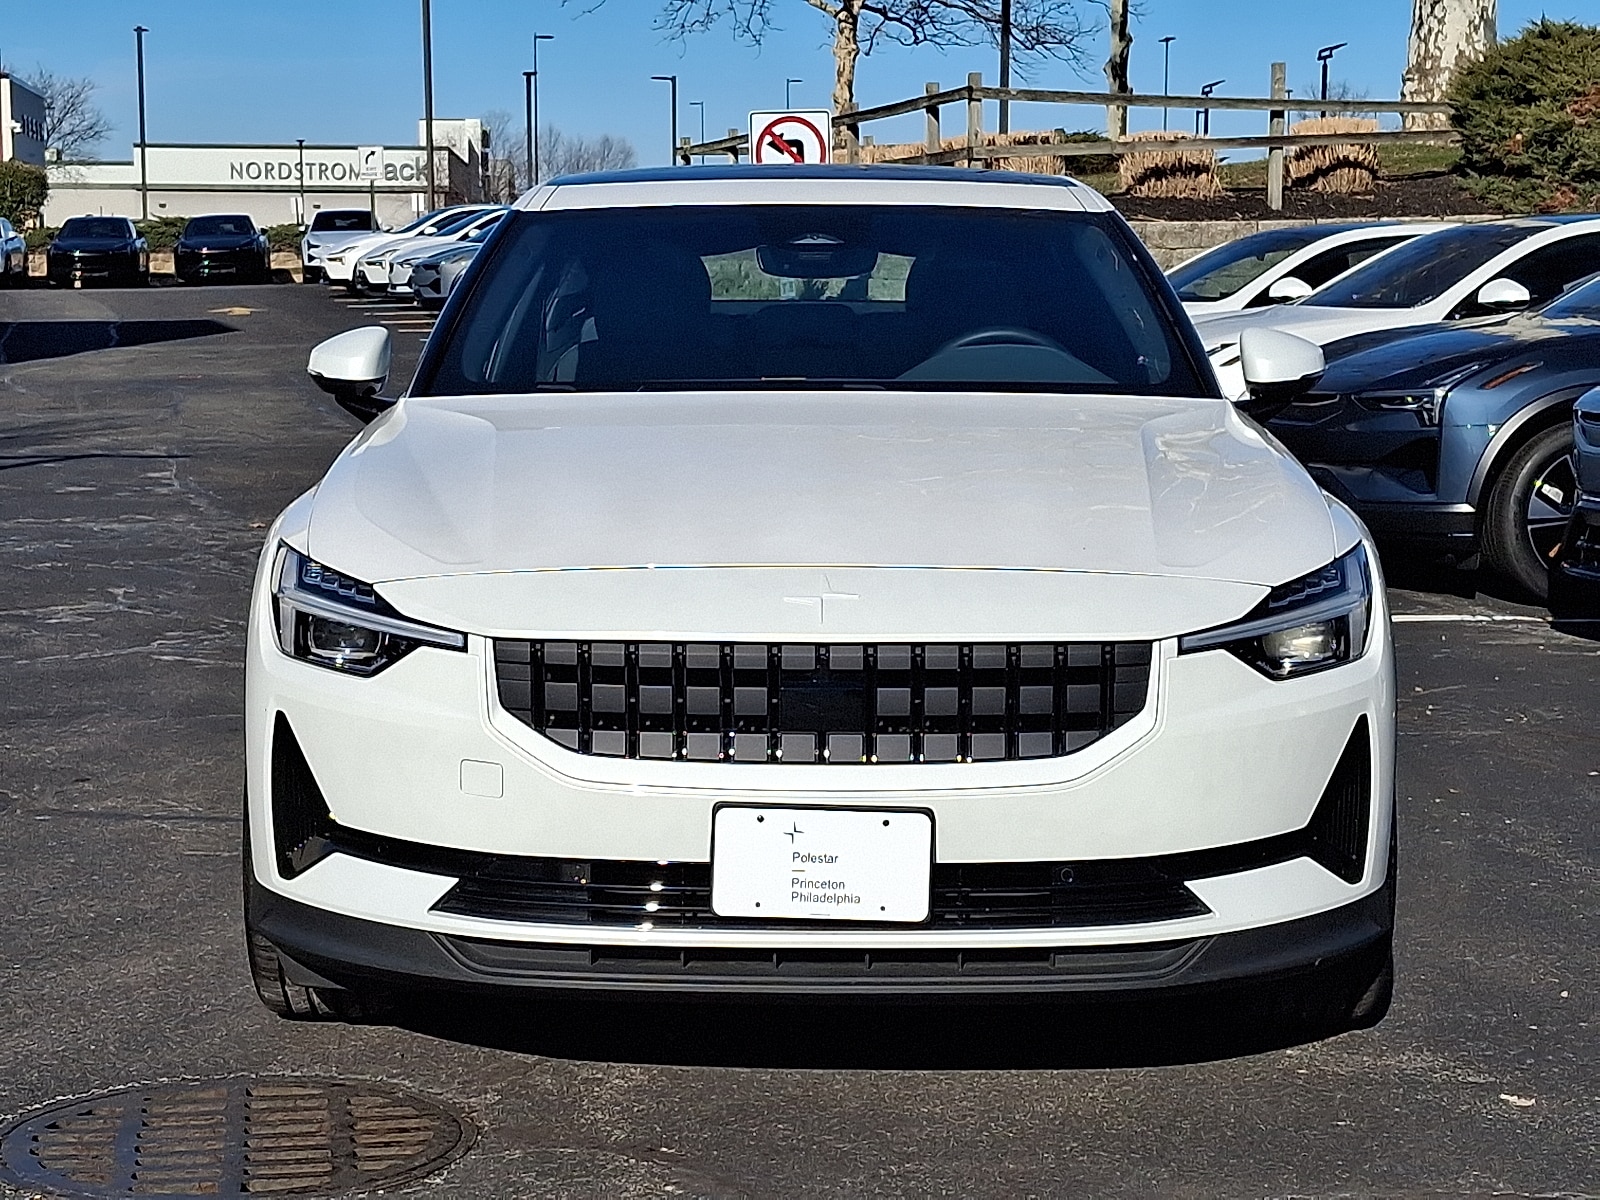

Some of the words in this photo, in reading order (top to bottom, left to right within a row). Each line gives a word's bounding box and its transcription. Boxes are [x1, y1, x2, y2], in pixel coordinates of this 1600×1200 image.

[384, 156, 428, 182] ack
[792, 851, 839, 864] Polestar
[791, 877, 846, 890] Princeton
[791, 891, 861, 906] Philadelphia
